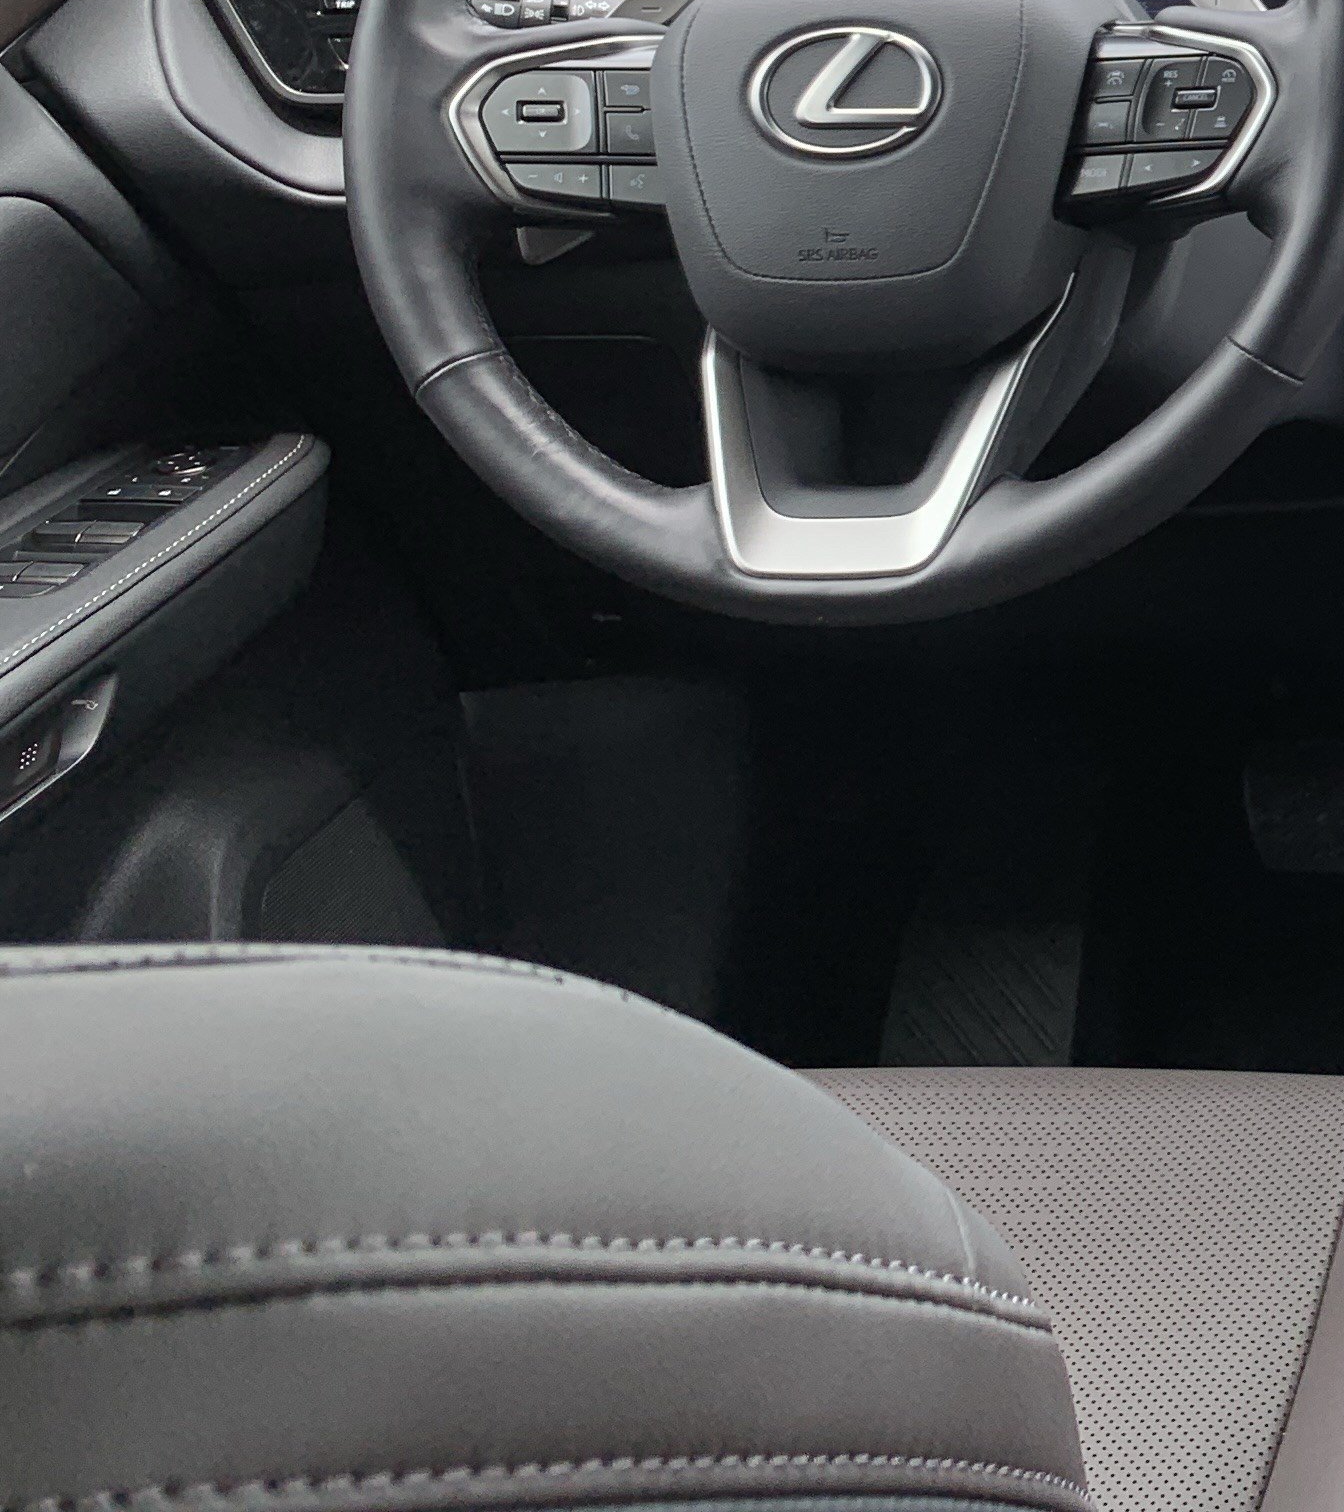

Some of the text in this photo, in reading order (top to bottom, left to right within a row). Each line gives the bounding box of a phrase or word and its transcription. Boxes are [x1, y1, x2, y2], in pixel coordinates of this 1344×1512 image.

[335, 0, 356, 9] TRIP
[1163, 70, 1179, 79] RES
[798, 247, 880, 262] SRS AIRBAG
